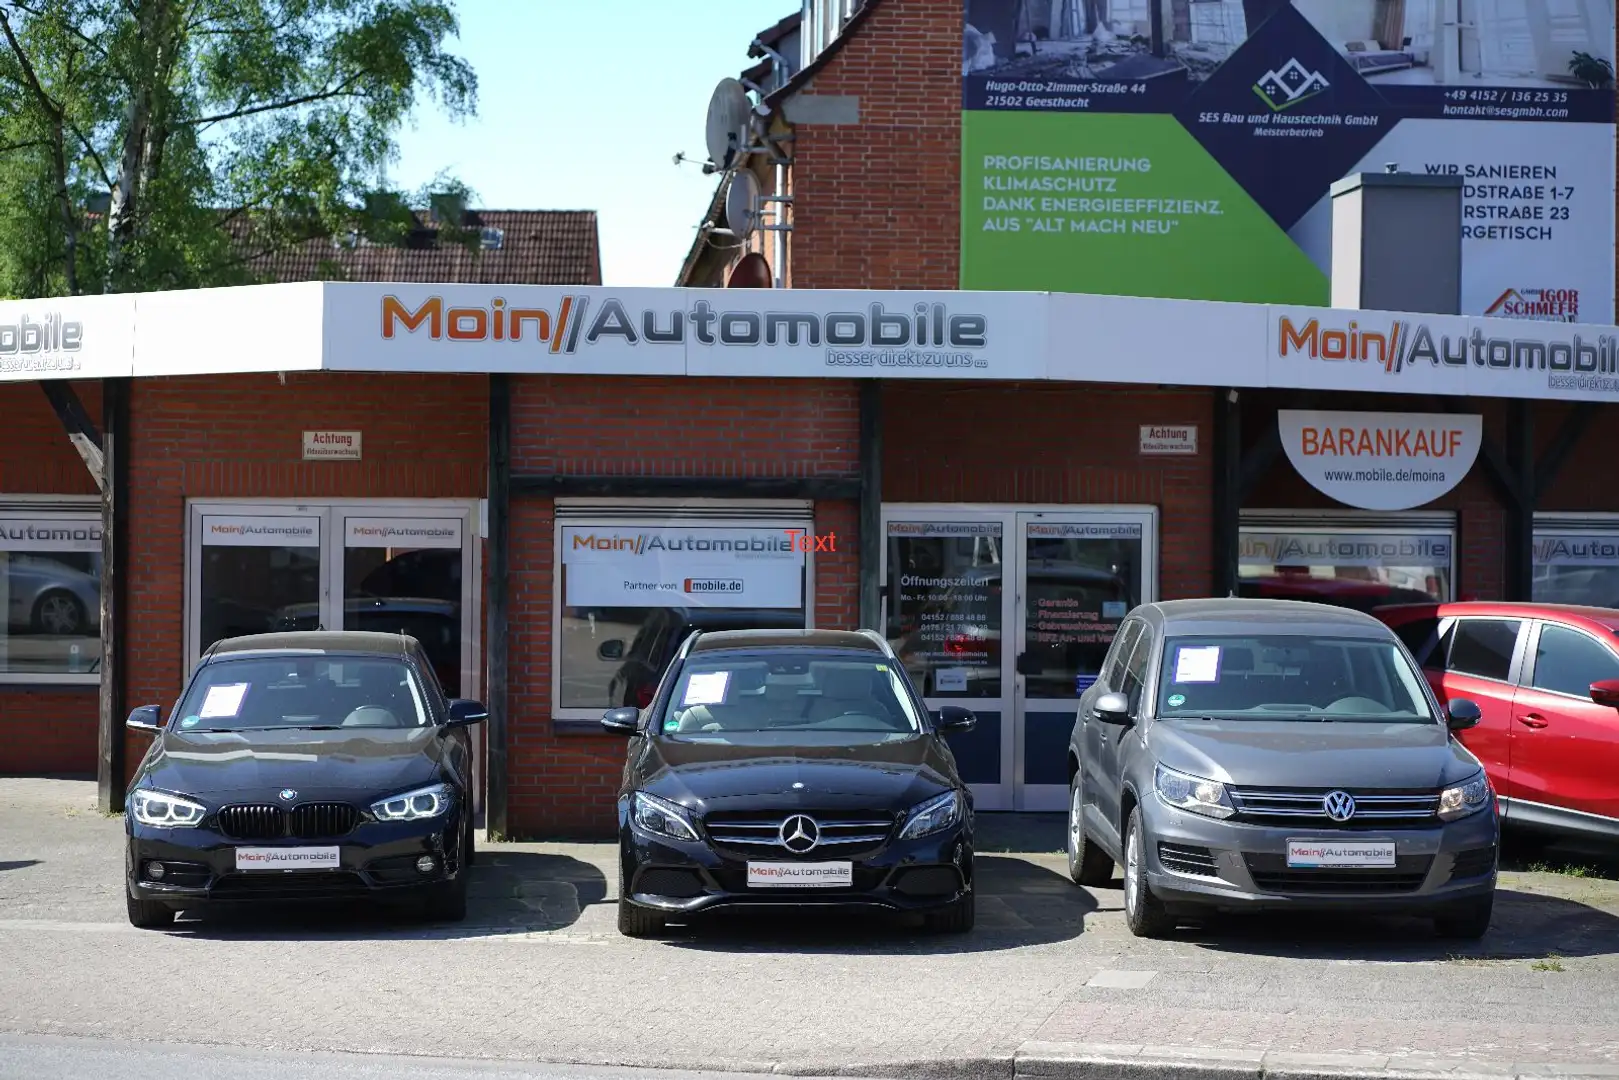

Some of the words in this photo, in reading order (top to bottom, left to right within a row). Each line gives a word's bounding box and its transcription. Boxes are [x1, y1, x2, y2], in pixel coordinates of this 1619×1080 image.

[986, 81, 1127, 94] Hugo-Otto-Zimmer-Straße
[1131, 83, 1146, 94] 44
[986, 95, 1022, 106] 21502
[1025, 96, 1089, 108] Geesthacht
[1443, 90, 1467, 100] +49
[1470, 90, 1498, 101] 4152
[1500, 91, 1507, 103] /
[1511, 91, 1531, 102] 136
[1534, 92, 1549, 102] 25
[1552, 92, 1568, 103] 35
[1443, 104, 1568, 118] kontakt@sesgmbh.com
[1198, 112, 1220, 123] SES
[1222, 113, 1244, 123] Bau
[1247, 113, 1269, 124] und
[1272, 113, 1341, 125] Haustechnik
[1344, 115, 1378, 126] GmbH
[1253, 127, 1324, 137] Meisterbetrieb
[983, 155, 1152, 172] PROFISANIERUNG
[1464, 164, 1557, 179] SANIEREN
[983, 175, 1117, 192] KLIMASCHUTZ
[1463, 185, 1545, 199] DSTRAßE
[1550, 186, 1575, 200] 1-7
[983, 196, 1035, 211] DANK
[1041, 198, 1224, 215] ENERGIEEFFIZIENZ.
[1463, 205, 1544, 220] RSTRAßE
[1550, 206, 1570, 220] 23
[982, 217, 1020, 232] AUS
[1025, 217, 1065, 232] "ALT
[1070, 218, 1126, 233] MACH
[1131, 219, 1179, 234] NEU"
[1461, 225, 1552, 240] RGETISCH
[1540, 288, 1578, 302] IGOR
[1279, 315, 1619, 374] Moin//Automobil
[825, 348, 876, 367] besser
[878, 349, 922, 367] direkt
[923, 352, 943, 367] zu
[312, 432, 352, 446] Achtung
[1149, 427, 1188, 441] Achtung
[1301, 427, 1463, 458] BARANKAUF
[1324, 468, 1445, 482] www.mobile.de/moina
[623, 580, 658, 590] Partner
[660, 582, 677, 590] von
[692, 580, 741, 590] mobile.de
[900, 573, 989, 588] Öffnungszeiten
